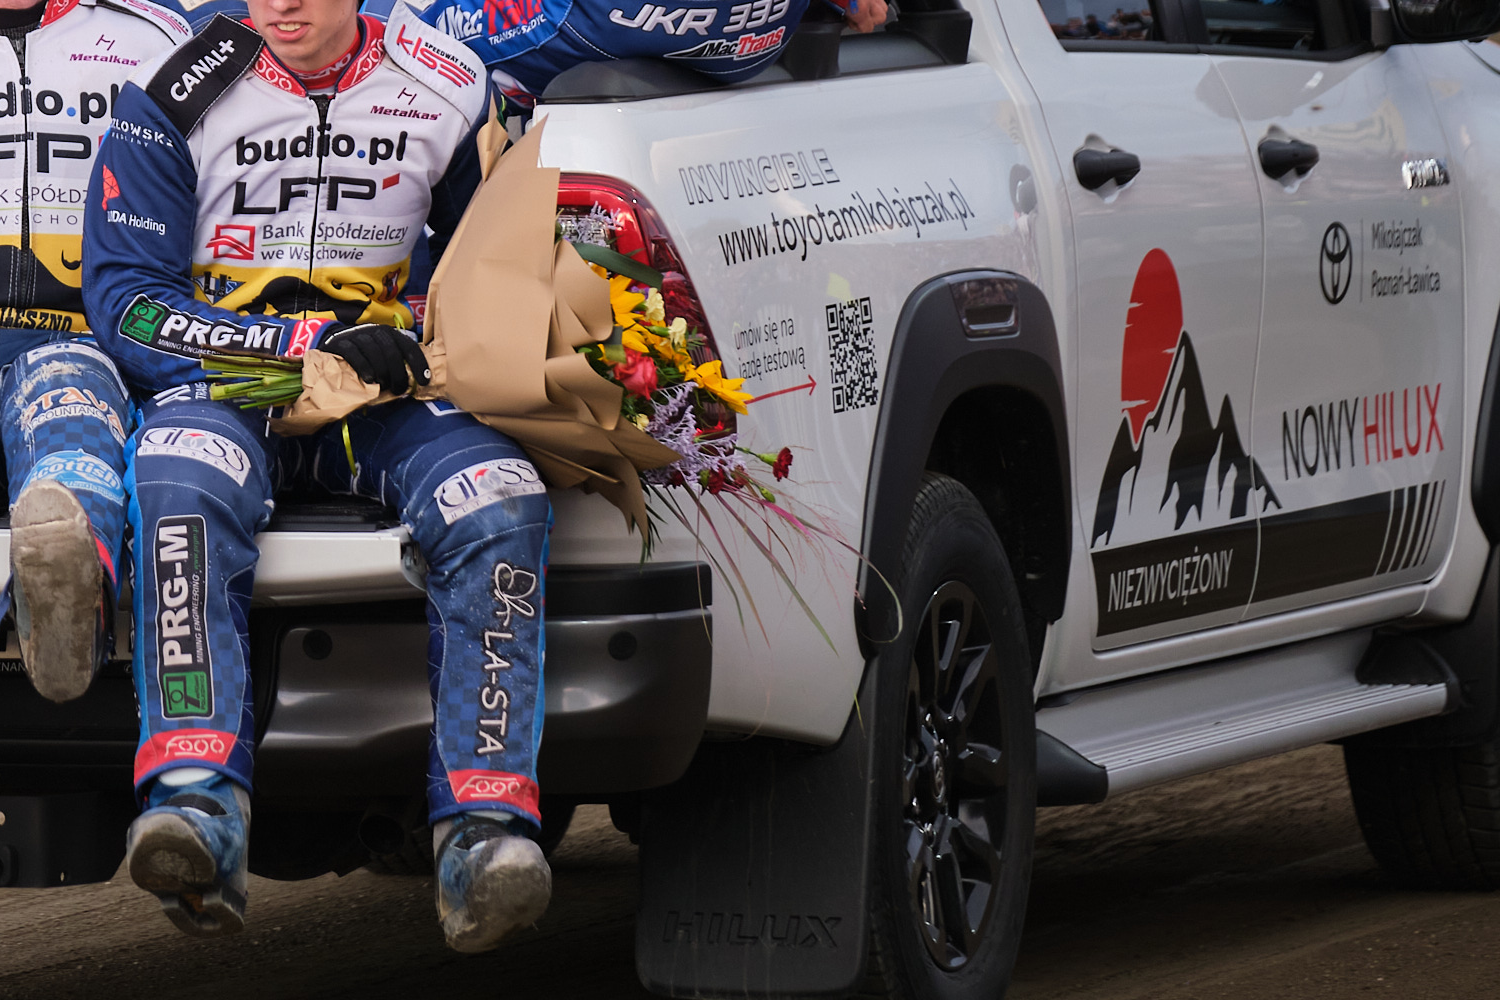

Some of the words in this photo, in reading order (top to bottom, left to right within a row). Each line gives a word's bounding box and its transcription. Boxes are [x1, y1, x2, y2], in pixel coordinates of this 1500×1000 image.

[609, 3, 718, 36] JKR
[70, 53, 139, 68] Metalkas
[169, 36, 237, 102] CANAL+
[424, 41, 459, 65] SPEEDWAY
[459, 60, 478, 80] PARTS
[370, 105, 440, 121] Metalkas
[236, 124, 409, 166] budio.pl
[678, 148, 841, 206] INVINCIBLE
[232, 175, 377, 217] LFP
[128, 214, 167, 235] Holding
[262, 223, 306, 241] Bank
[316, 220, 409, 244] Spółdzielczy
[718, 177, 976, 267] www.toyotamikolajczak.pl
[261, 248, 286, 262] we
[288, 245, 364, 263] Wschowie
[1370, 259, 1441, 298] Poznań-Ławica
[0, 308, 73, 332] LESZNO
[160, 314, 277, 349] PRG-M
[733, 321, 764, 351] umów
[763, 317, 780, 347] się
[781, 317, 795, 337] na
[157, 338, 182, 351] MINING
[762, 343, 807, 374] testową
[1281, 396, 1359, 481] NOWY
[1363, 382, 1445, 466] HILUX
[159, 524, 193, 667] PRG-M
[1108, 546, 1234, 614] NIEZWYCIĘŻONY
[192, 573, 204, 630] ENGINEERING
[196, 630, 205, 664] MINING
[477, 629, 513, 757] LA-STA
[164, 734, 226, 758] Fogo
[456, 774, 522, 802] Fogo
[660, 909, 844, 950] HILUX
